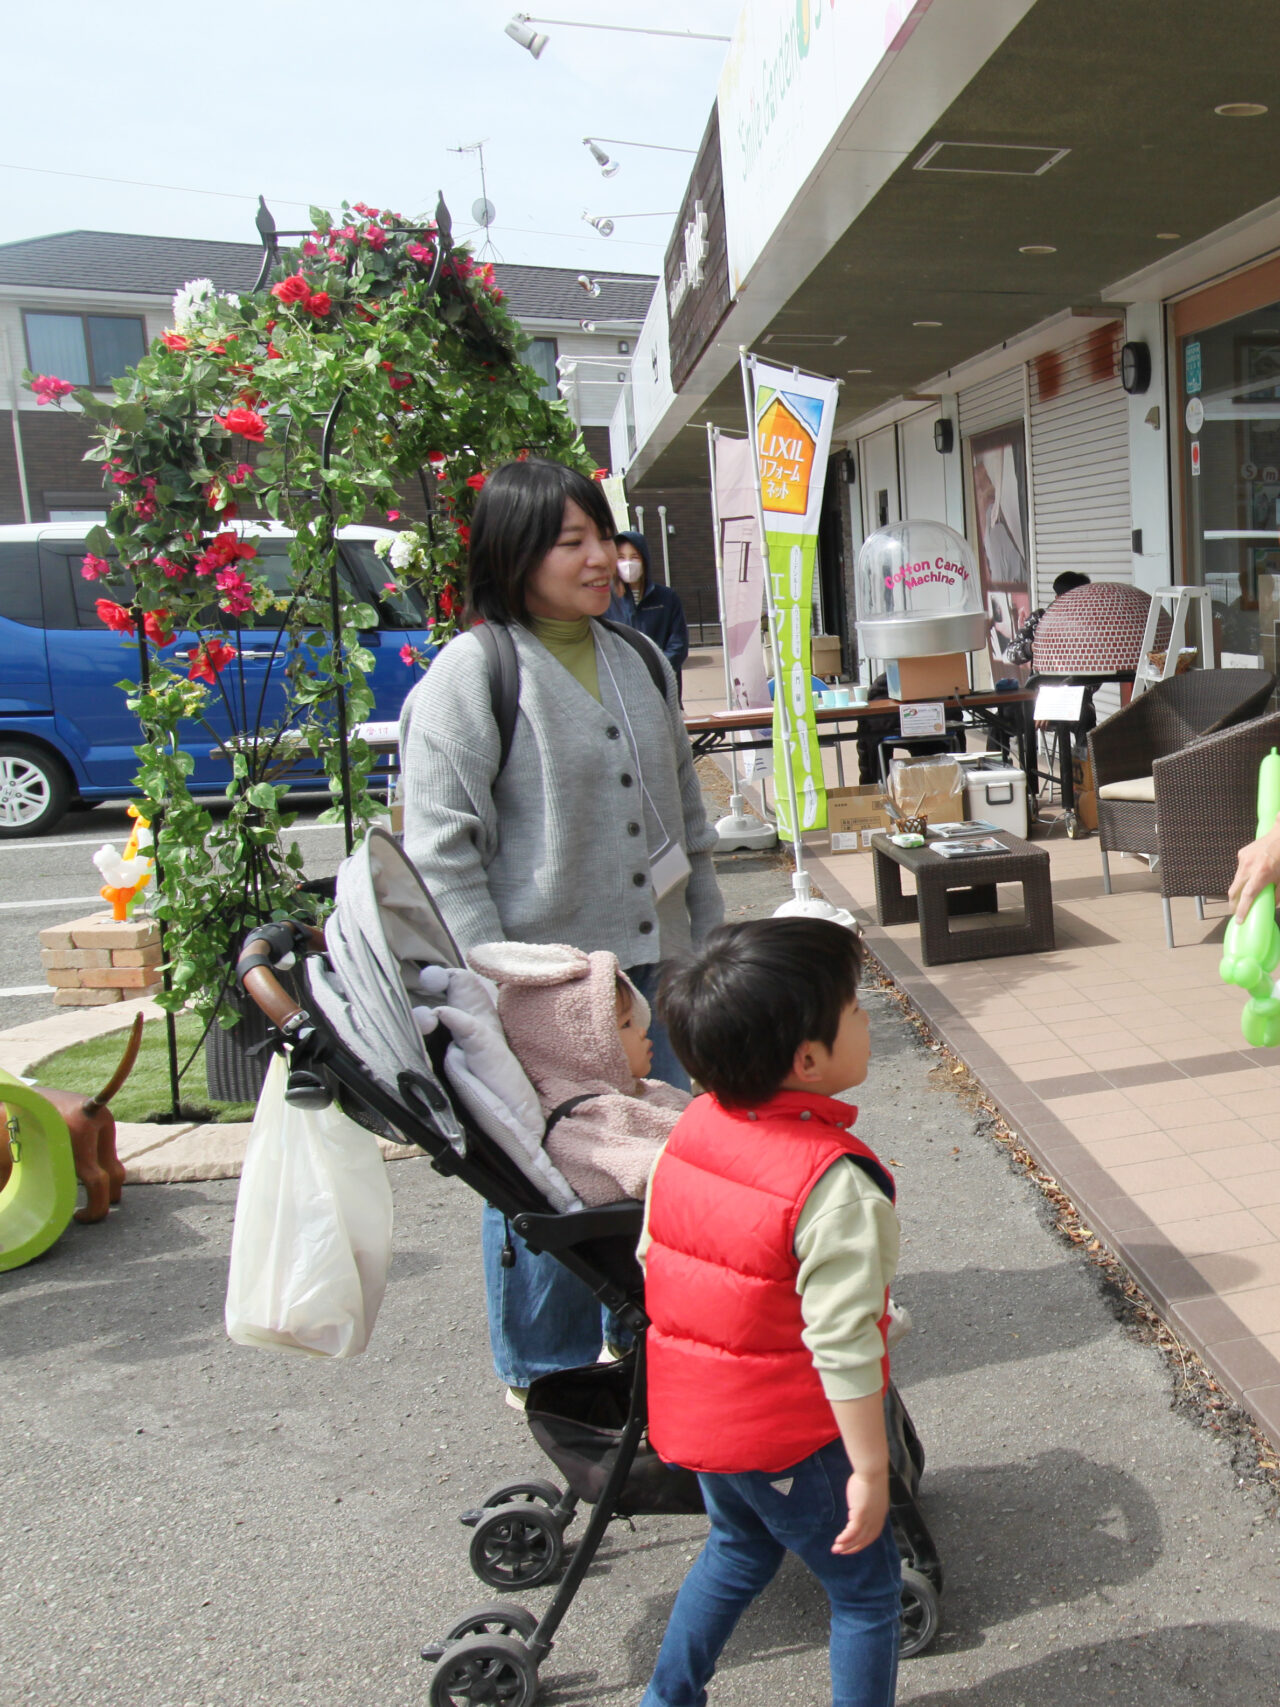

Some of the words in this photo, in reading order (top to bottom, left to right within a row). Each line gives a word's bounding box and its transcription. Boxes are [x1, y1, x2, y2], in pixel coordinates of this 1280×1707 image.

[759, 433, 805, 463] LIXIL
[759, 458, 801, 483] リフォーム
[766, 480, 790, 501] ネット
[884, 560, 932, 590] Cotton
[934, 556, 971, 582] Candy
[905, 571, 956, 591] Machine
